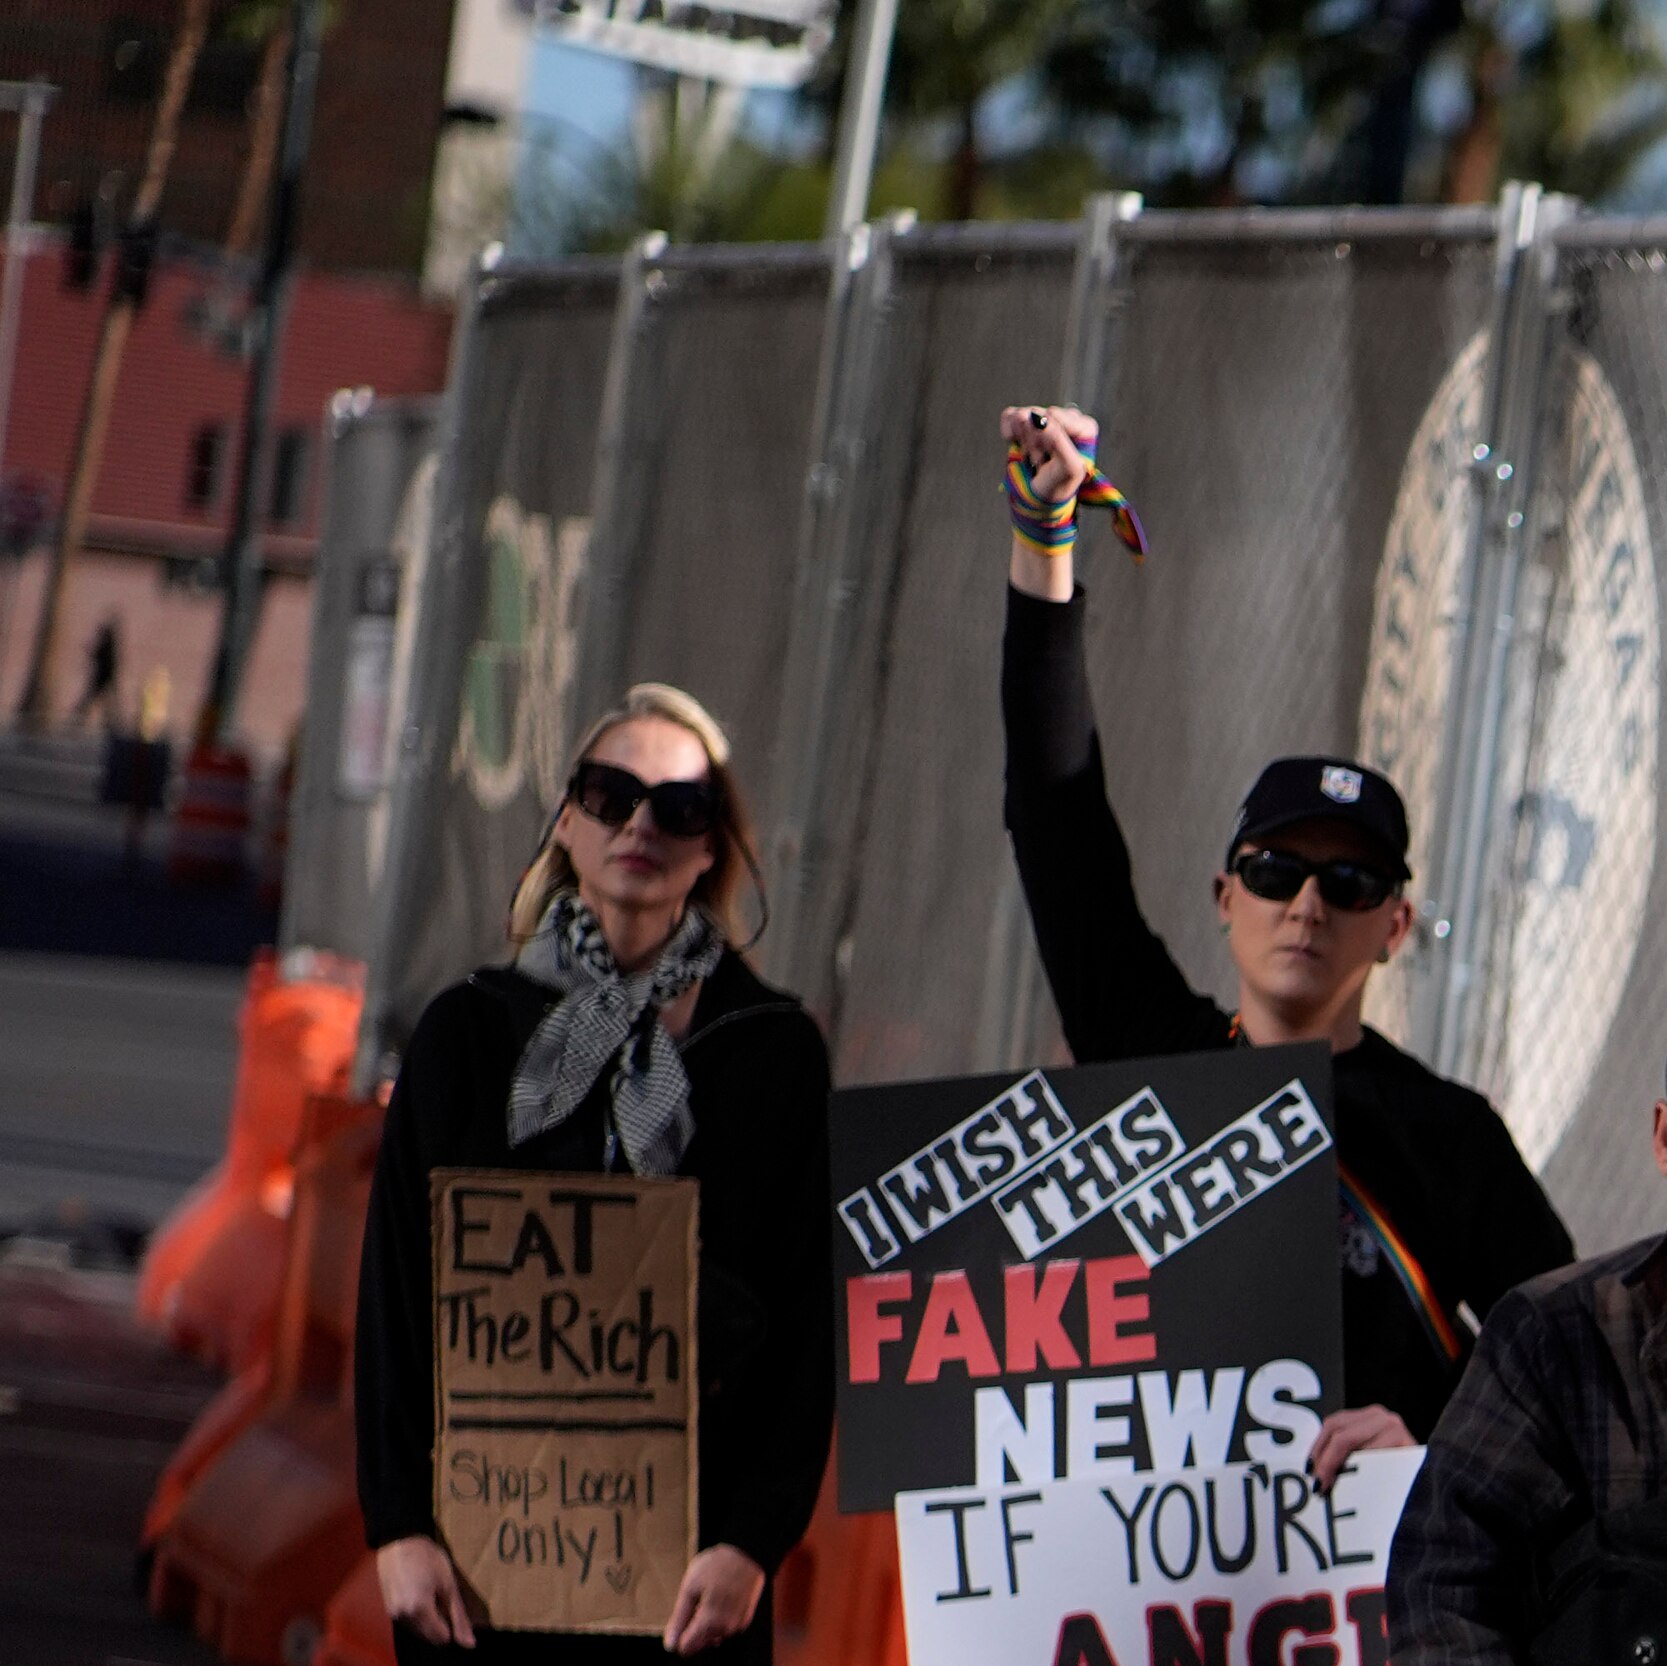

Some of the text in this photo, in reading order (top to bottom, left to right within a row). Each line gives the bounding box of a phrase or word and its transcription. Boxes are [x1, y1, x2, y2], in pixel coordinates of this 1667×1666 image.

[452, 1187, 637, 1278] EAT
[842, 1078, 1067, 1262] I WISH
[1000, 1094, 1177, 1245] THIS
[1119, 1092, 1327, 1257] WERE
[845, 1252, 1157, 1385] FAKE
[449, 1450, 655, 1518] Shop Local
[974, 1357, 1323, 1490] NEWS
[925, 1461, 1375, 1604] IF YOU'RE
